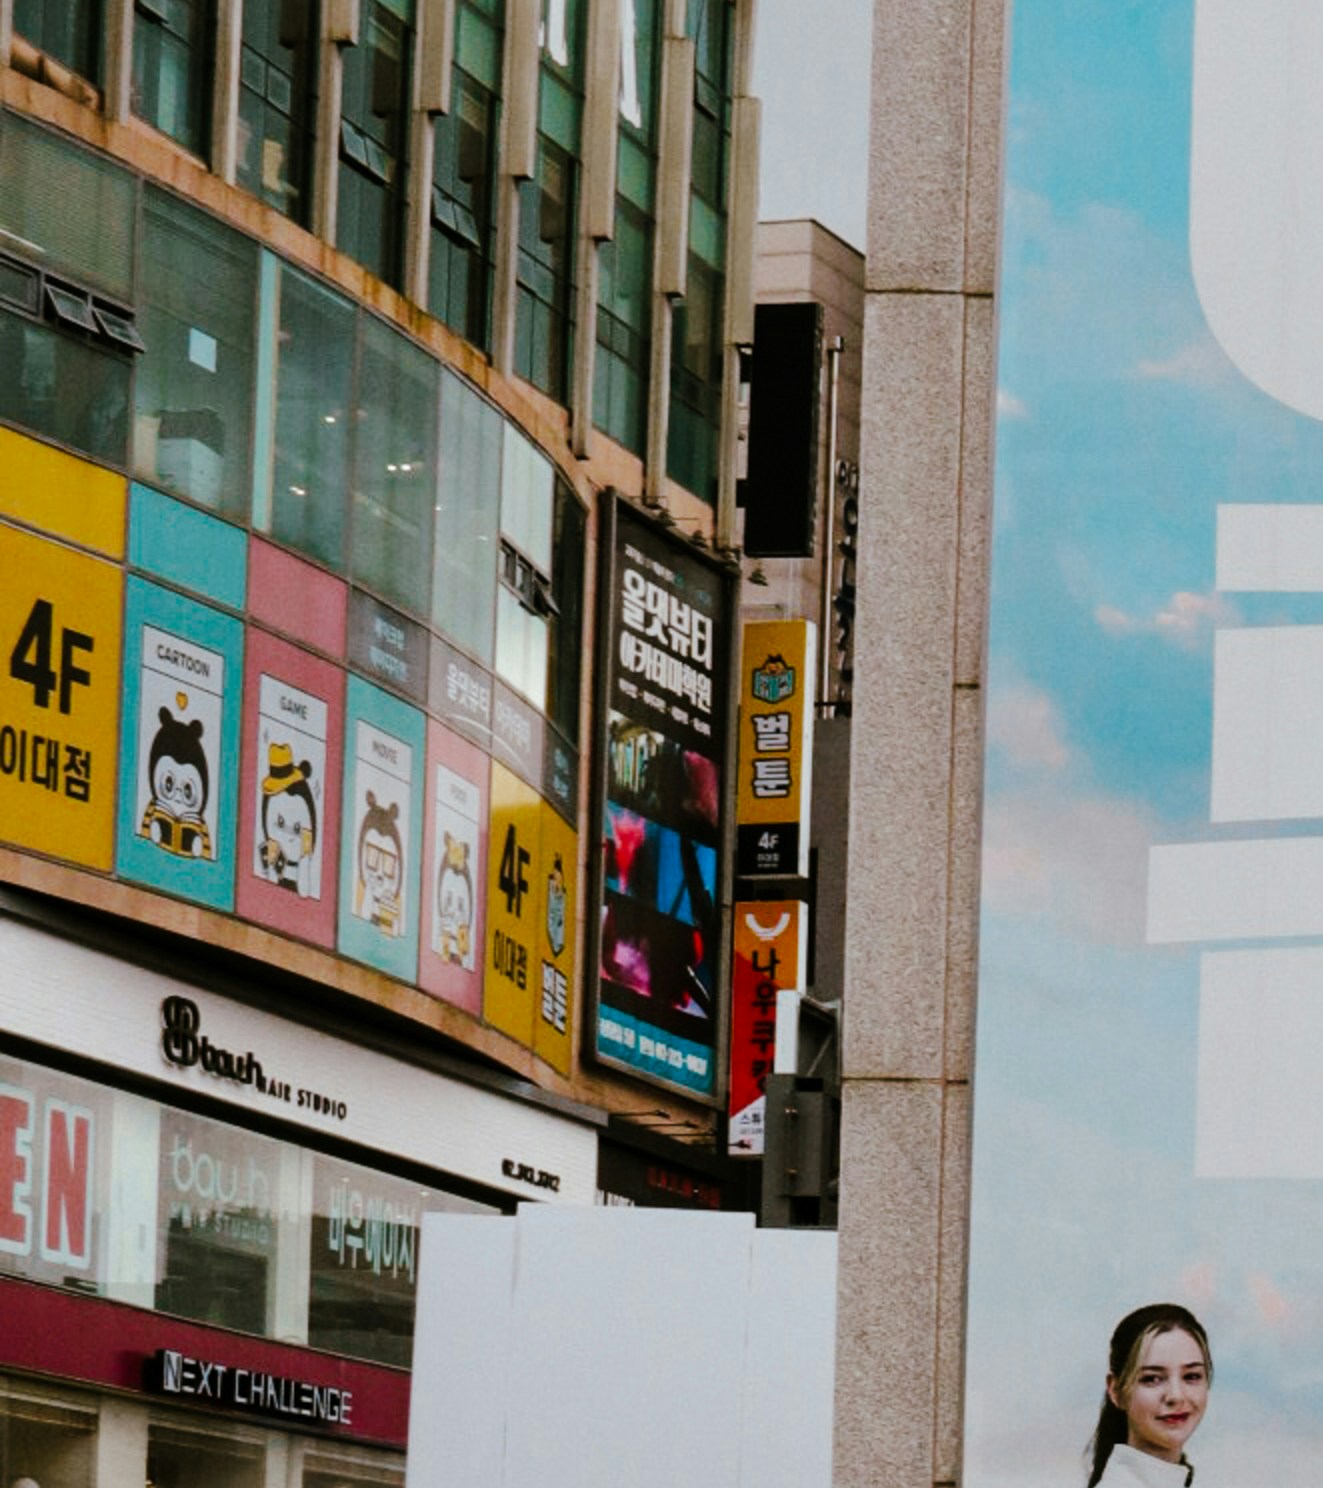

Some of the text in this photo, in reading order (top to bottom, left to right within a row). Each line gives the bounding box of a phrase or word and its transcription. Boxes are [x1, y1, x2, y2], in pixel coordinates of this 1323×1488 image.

[10, 598, 94, 715] 4F
[622, 568, 713, 671] 올댓뷰티
[156, 643, 211, 678] CARTOON
[619, 630, 712, 715] 아카데미학원
[280, 695, 308, 721] GAME
[0, 725, 91, 803] 이대점
[498, 823, 531, 918] 4F
[757, 832, 780, 849] 4F
[297, 1088, 348, 1120] STUDIO
[163, 1349, 353, 1425] NEXT CHALLENGE
